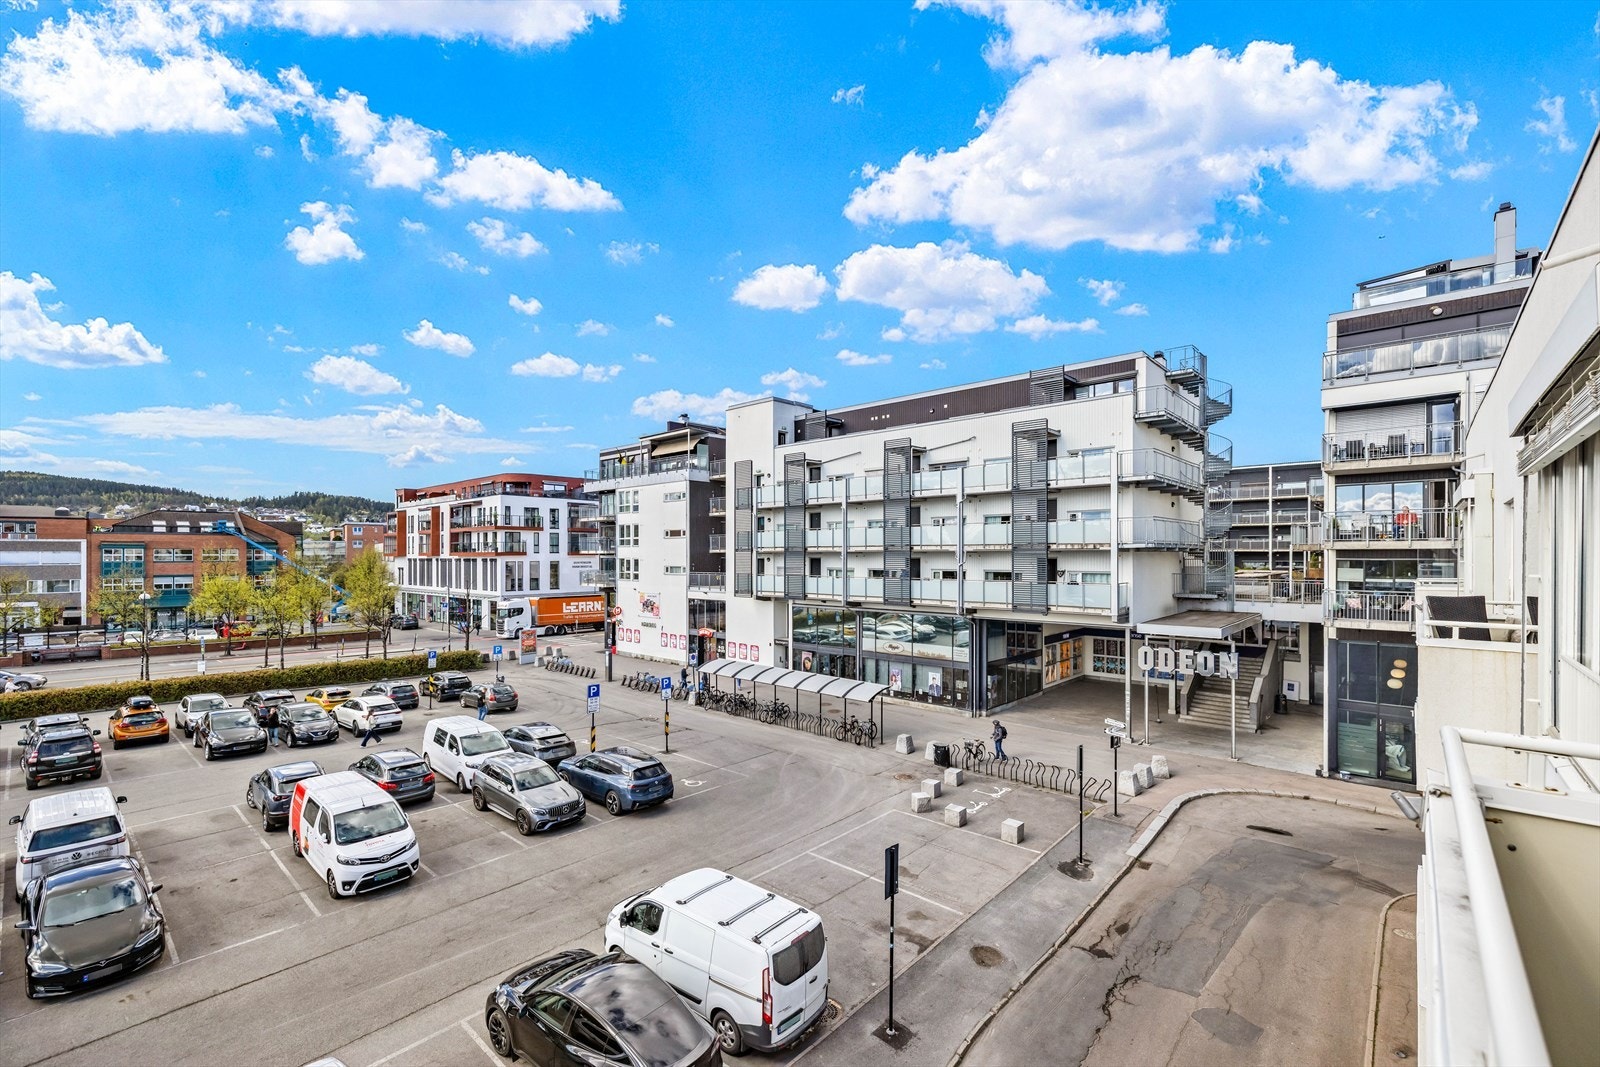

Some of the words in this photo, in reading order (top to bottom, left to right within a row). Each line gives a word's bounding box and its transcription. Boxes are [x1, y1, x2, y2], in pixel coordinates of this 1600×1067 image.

[1138, 646, 1239, 679] ODEON
[663, 679, 668, 688] P
[590, 686, 597, 696] P
